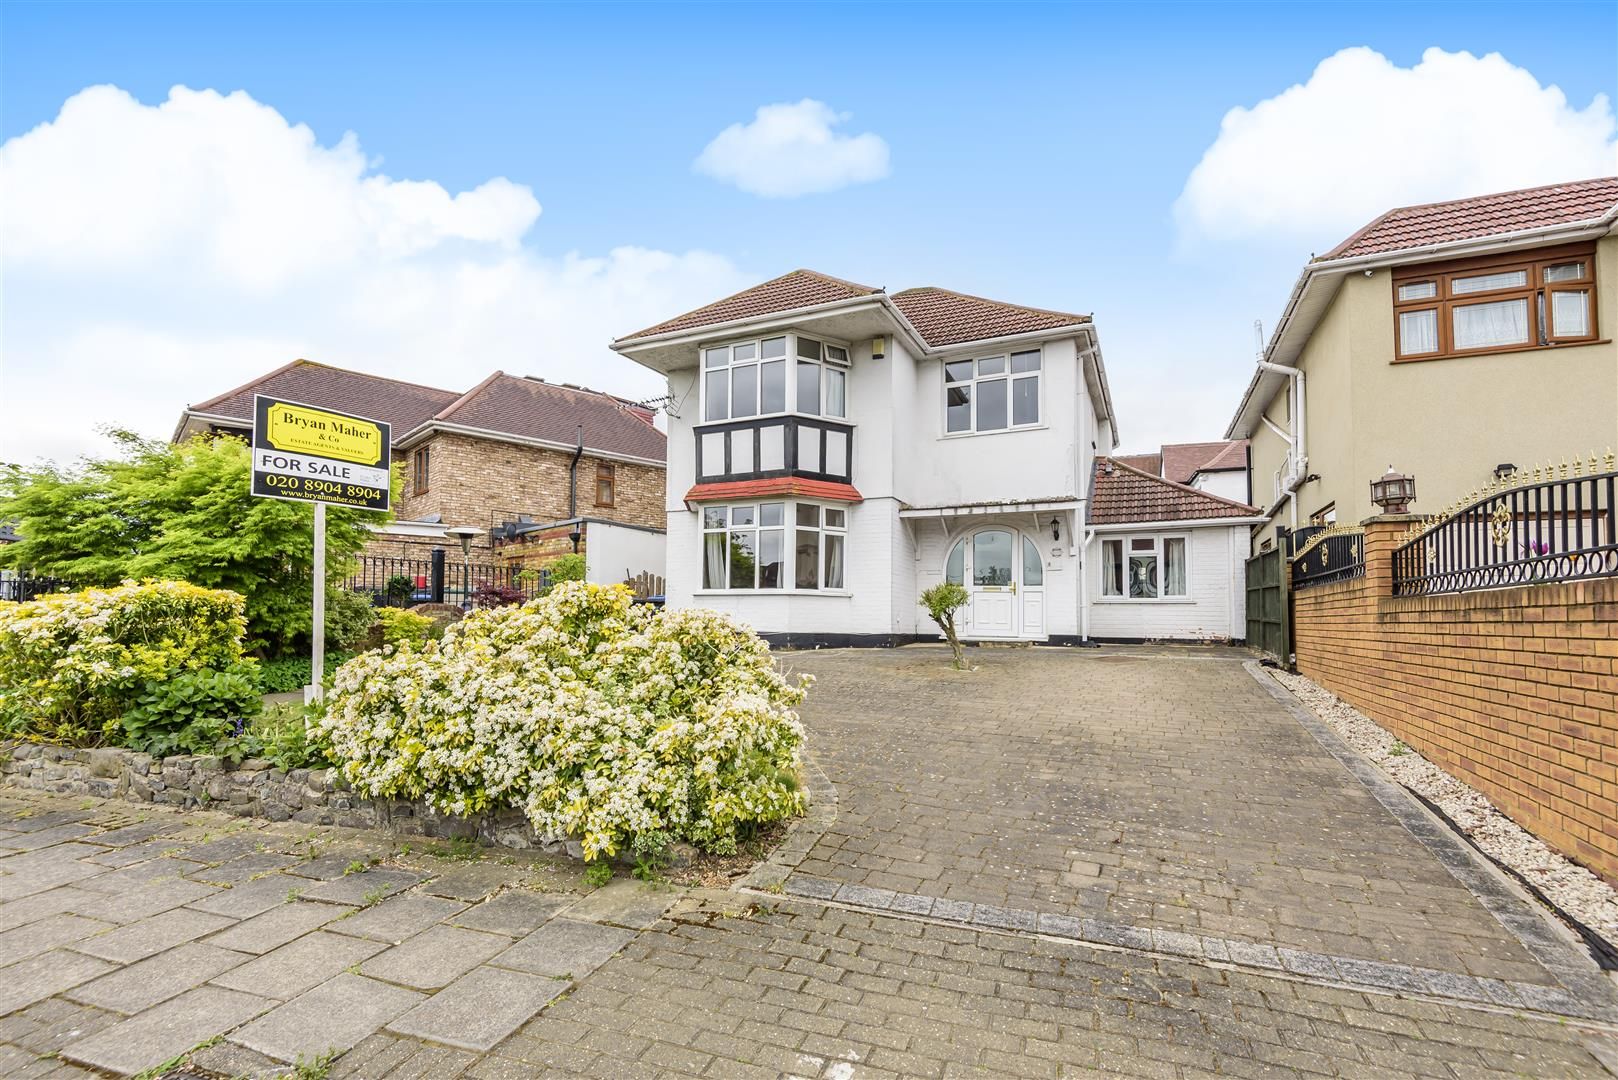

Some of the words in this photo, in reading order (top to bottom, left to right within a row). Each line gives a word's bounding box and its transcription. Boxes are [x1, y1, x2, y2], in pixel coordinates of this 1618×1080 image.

[283, 412, 326, 430] Bryan
[331, 422, 372, 439] Maher
[290, 438, 312, 446] ESTATE
[313, 442, 335, 450] AGENTS
[328, 435, 340, 443] Co
[262, 455, 301, 471] FOR
[308, 462, 351, 479] SALE
[266, 474, 299, 489] 020
[304, 479, 342, 495] 8904
[347, 485, 381, 500] 8904
[280, 489, 367, 506] www.bryanmaher.co.uk
